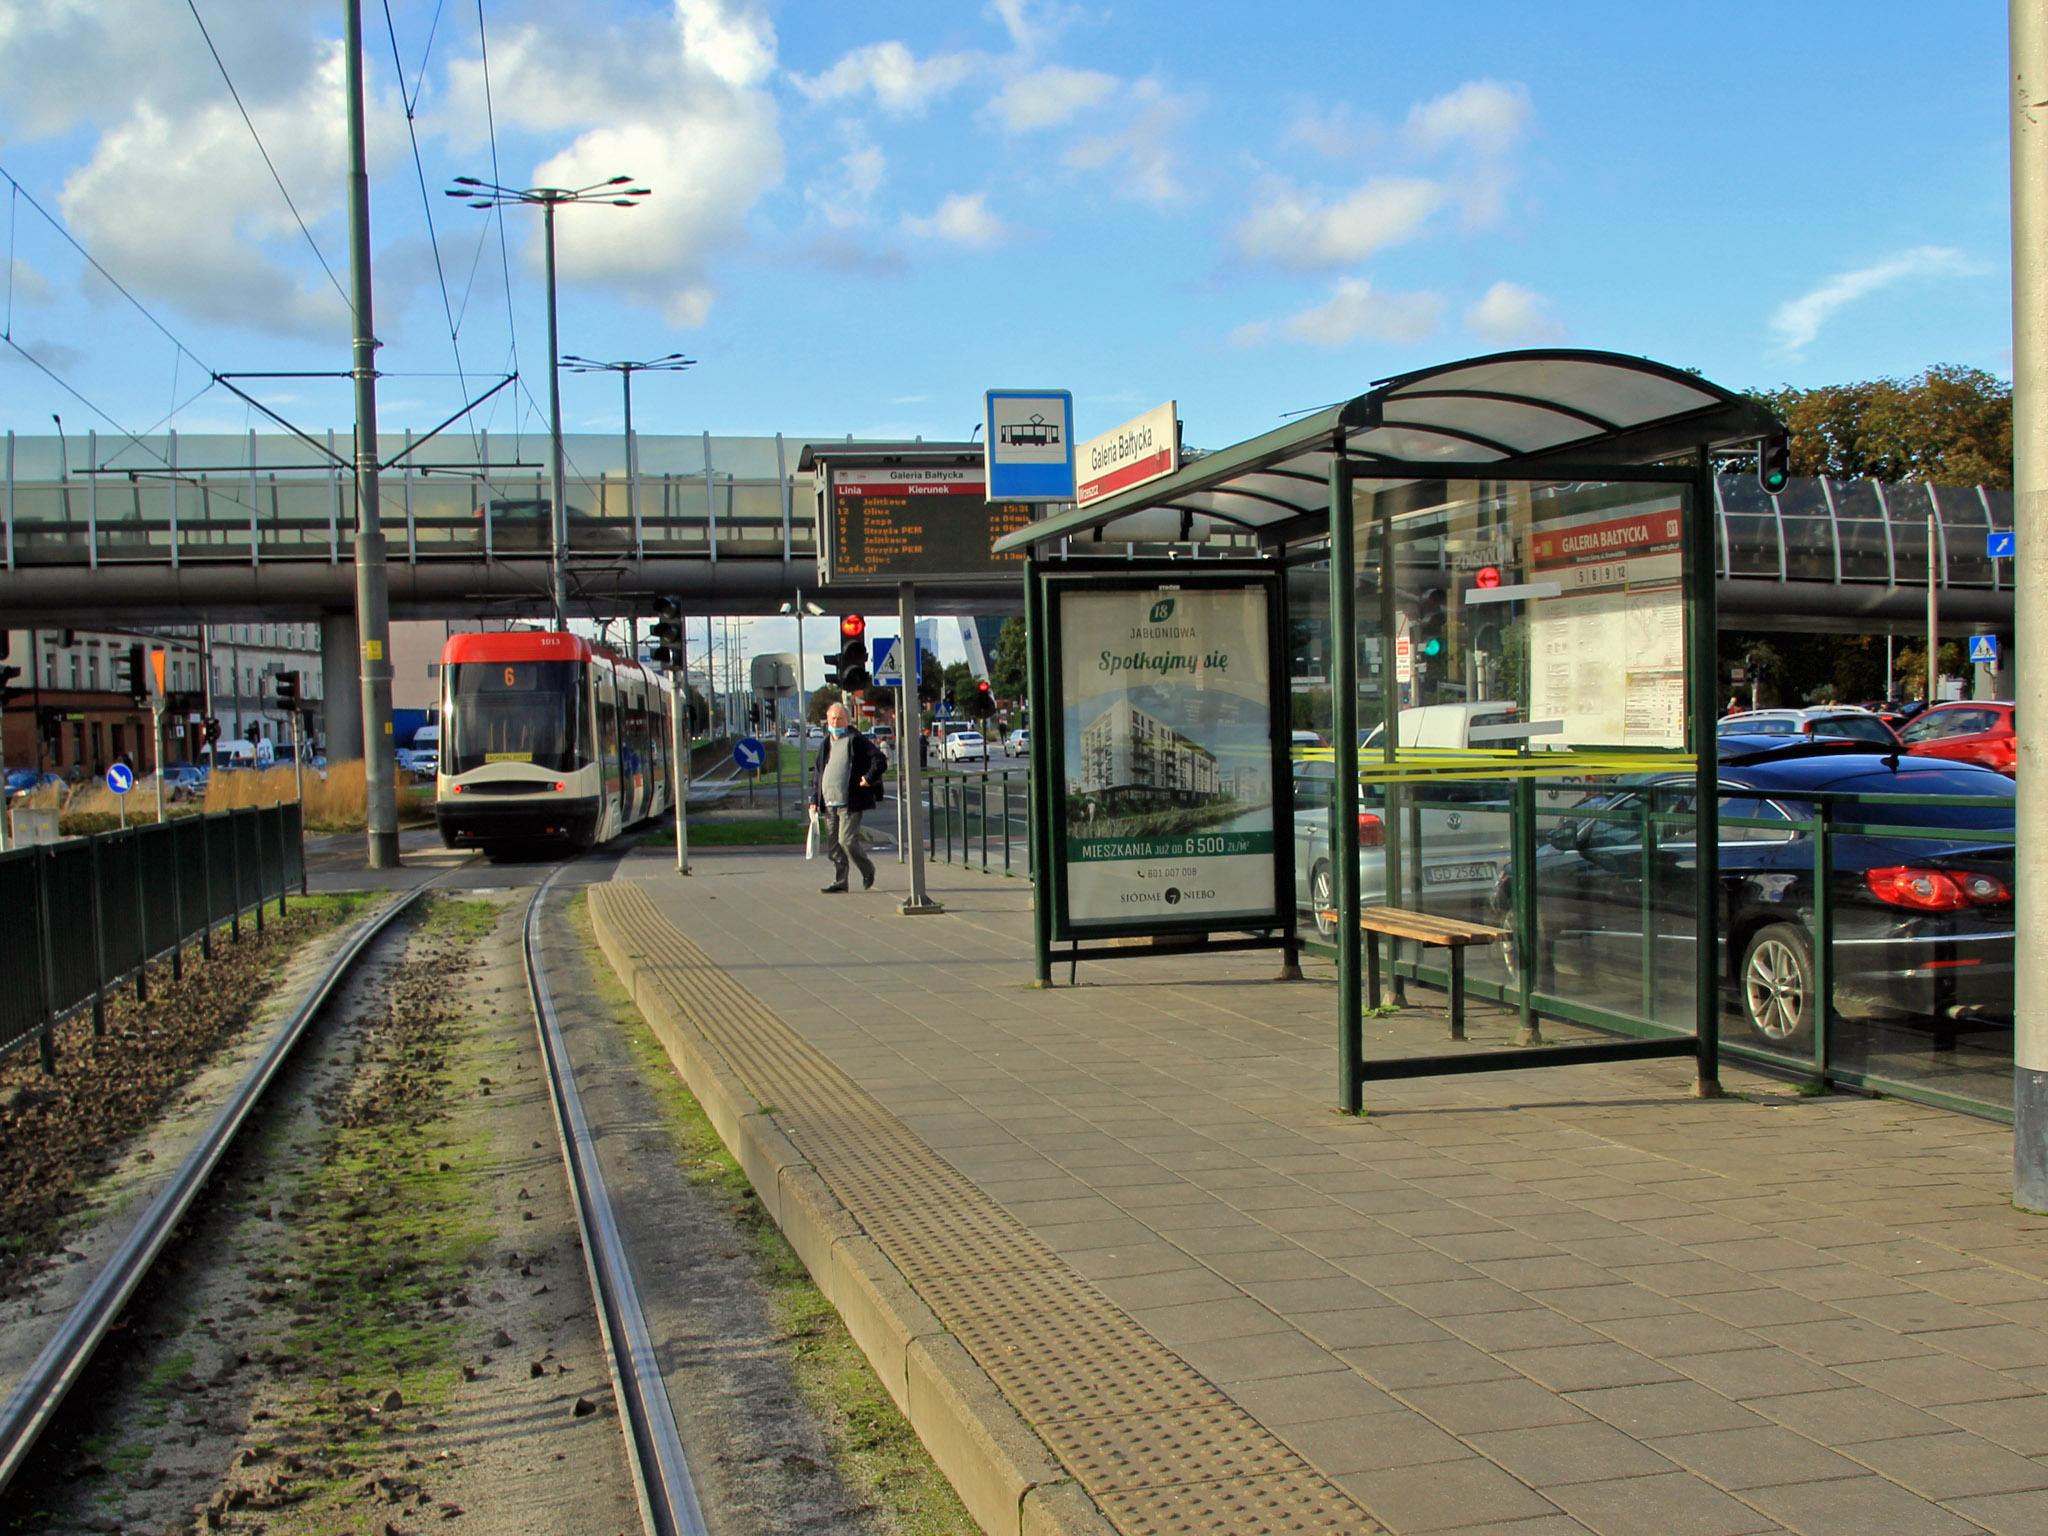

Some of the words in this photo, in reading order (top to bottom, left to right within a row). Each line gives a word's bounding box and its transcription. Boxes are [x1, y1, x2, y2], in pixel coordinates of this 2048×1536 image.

[1091, 440, 1117, 471] Galeria
[1118, 424, 1152, 460] Bałtycka
[890, 471, 922, 480] Galeria
[925, 471, 963, 480] Bałtycka
[839, 486, 862, 495] Linia
[908, 485, 950, 494] Kierunek
[1562, 532, 1600, 553] GALERIA
[1600, 525, 1649, 546] BAŁTYCKA
[1617, 566, 1626, 578] 12
[1154, 604, 1168, 619] 18
[1130, 627, 1196, 639] JABŁONIOWA
[1099, 651, 1199, 675] Spotkajmy
[1203, 650, 1229, 672] się
[504, 667, 514, 687] 6
[1082, 843, 1152, 858] MIESZKANIA
[1171, 845, 1183, 854] OD
[1183, 889, 1216, 900] NIEBO
